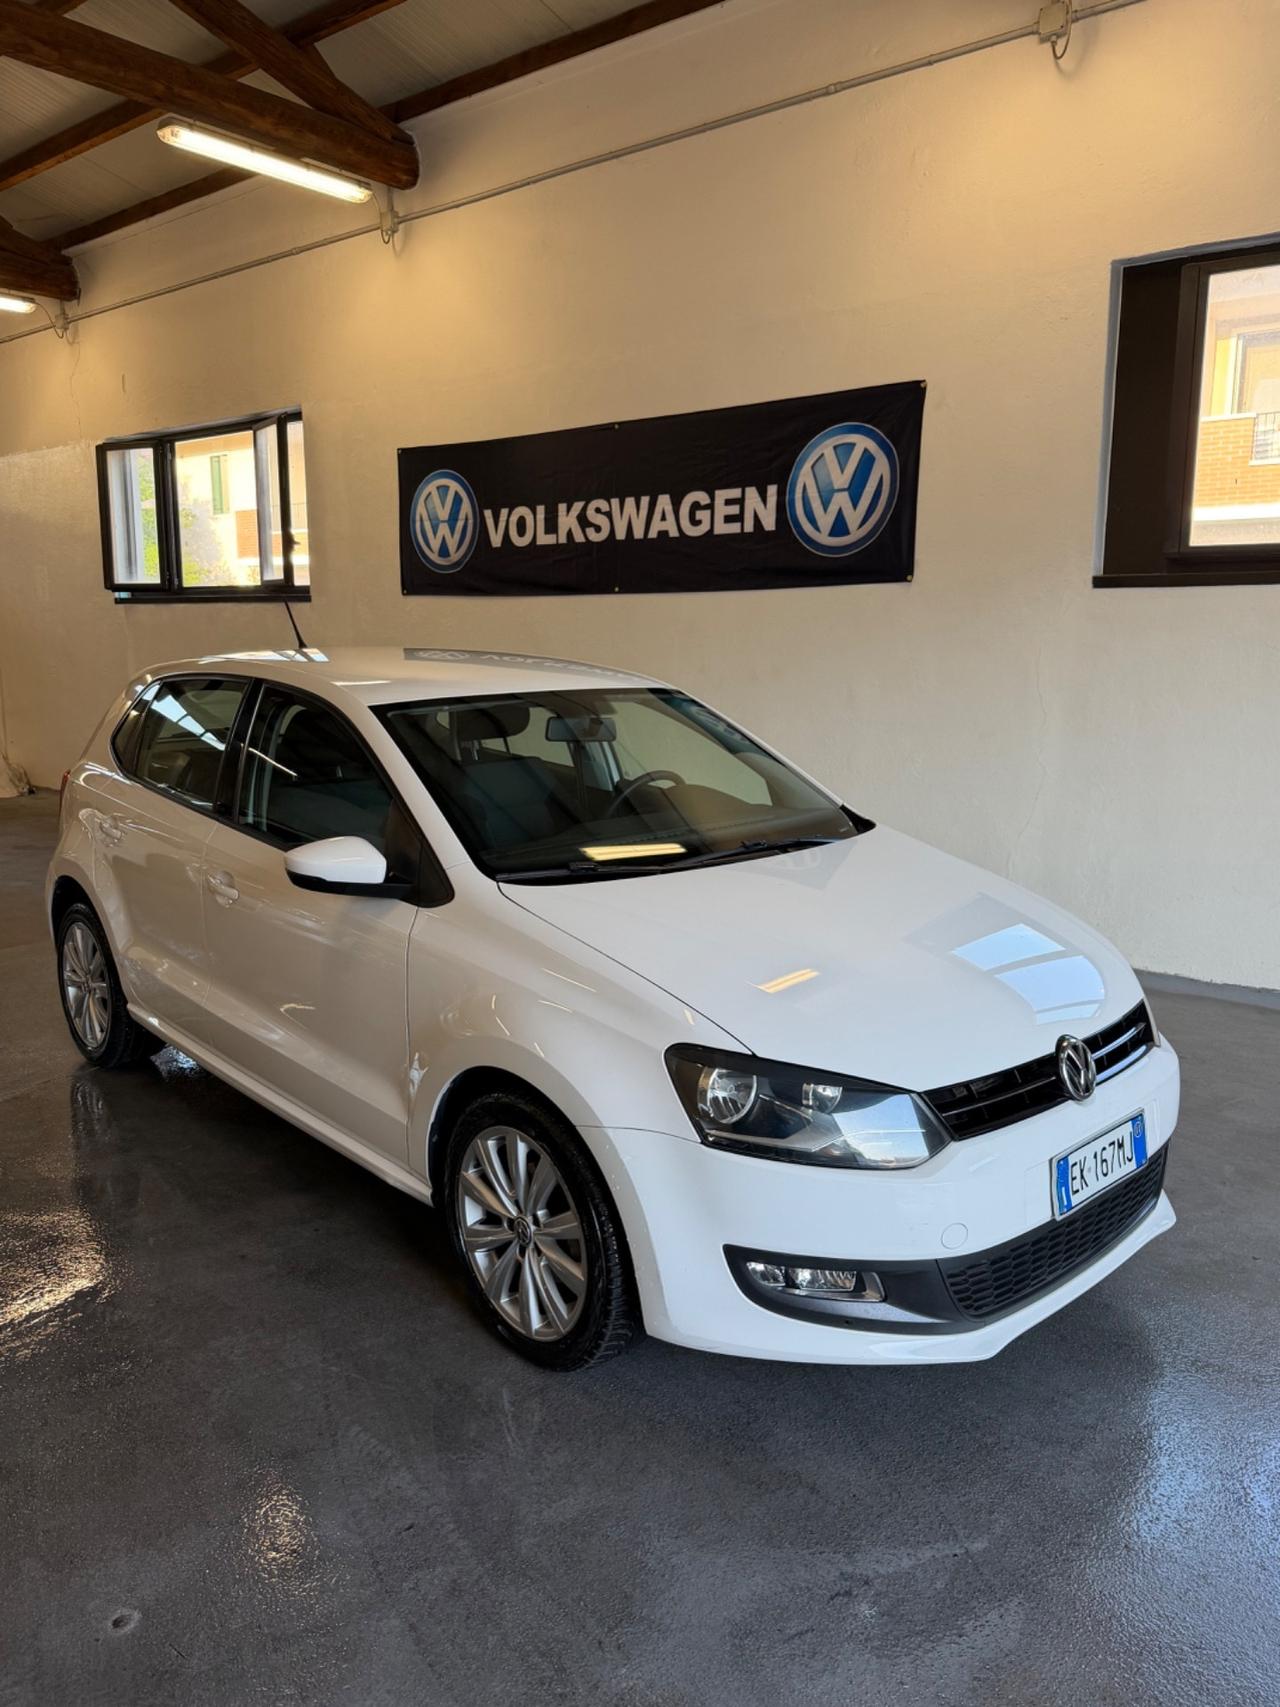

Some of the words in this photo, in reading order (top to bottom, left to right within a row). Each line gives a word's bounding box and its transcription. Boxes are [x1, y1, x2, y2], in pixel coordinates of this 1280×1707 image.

[415, 477, 474, 566] VW
[484, 484, 778, 548] VOLKSWAGEN
[796, 432, 893, 546] VW
[1071, 1156, 1089, 1196] EK
[1093, 1131, 1133, 1182] 167MJ
